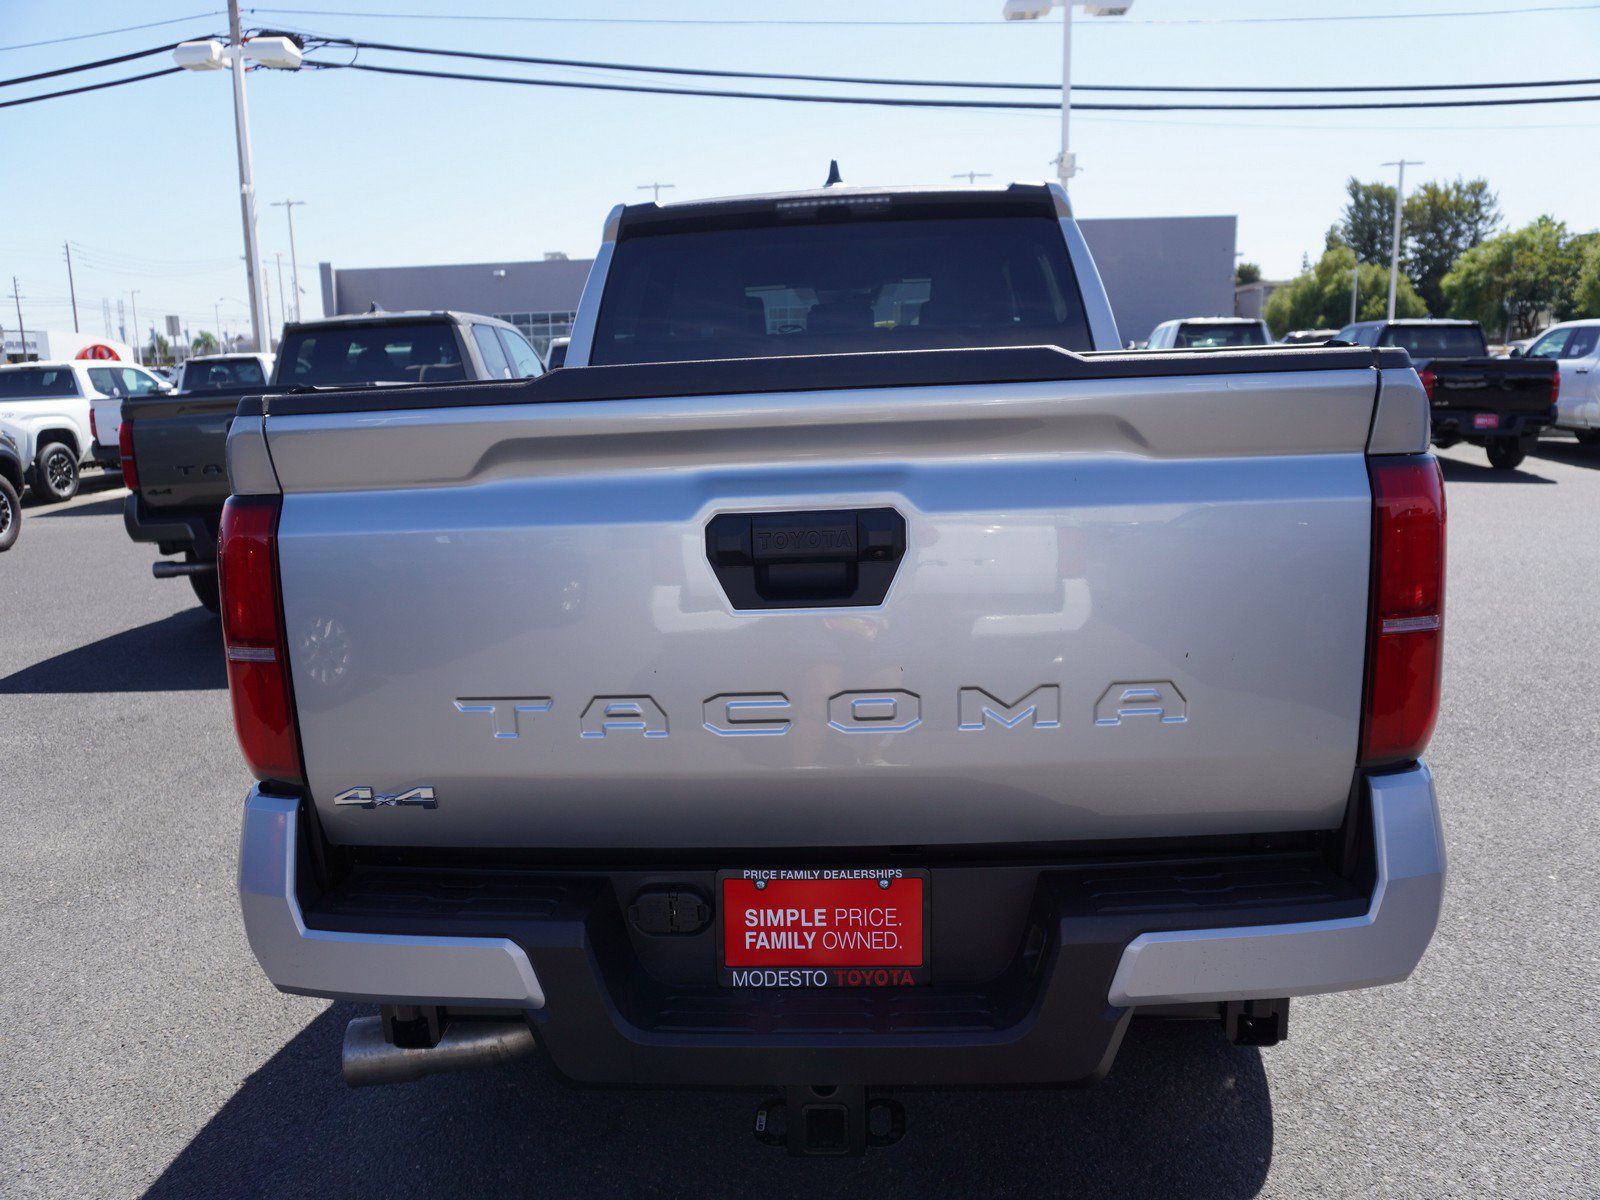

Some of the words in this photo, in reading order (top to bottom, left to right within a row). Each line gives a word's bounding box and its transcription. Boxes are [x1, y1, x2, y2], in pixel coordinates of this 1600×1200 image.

[757, 529, 853, 550] TOYOTA
[453, 679, 1188, 739] TACOMA
[743, 870, 777, 880] PRICE
[780, 870, 821, 880] FAMILY
[823, 869, 903, 879] DEALERSHIPS
[744, 908, 827, 927] SIMPLE
[834, 907, 903, 927] PRICE.
[745, 931, 816, 950] FAMILY
[822, 931, 903, 950] OWNED.
[732, 970, 828, 987] MODESTO
[834, 969, 915, 986] TOYOTA
